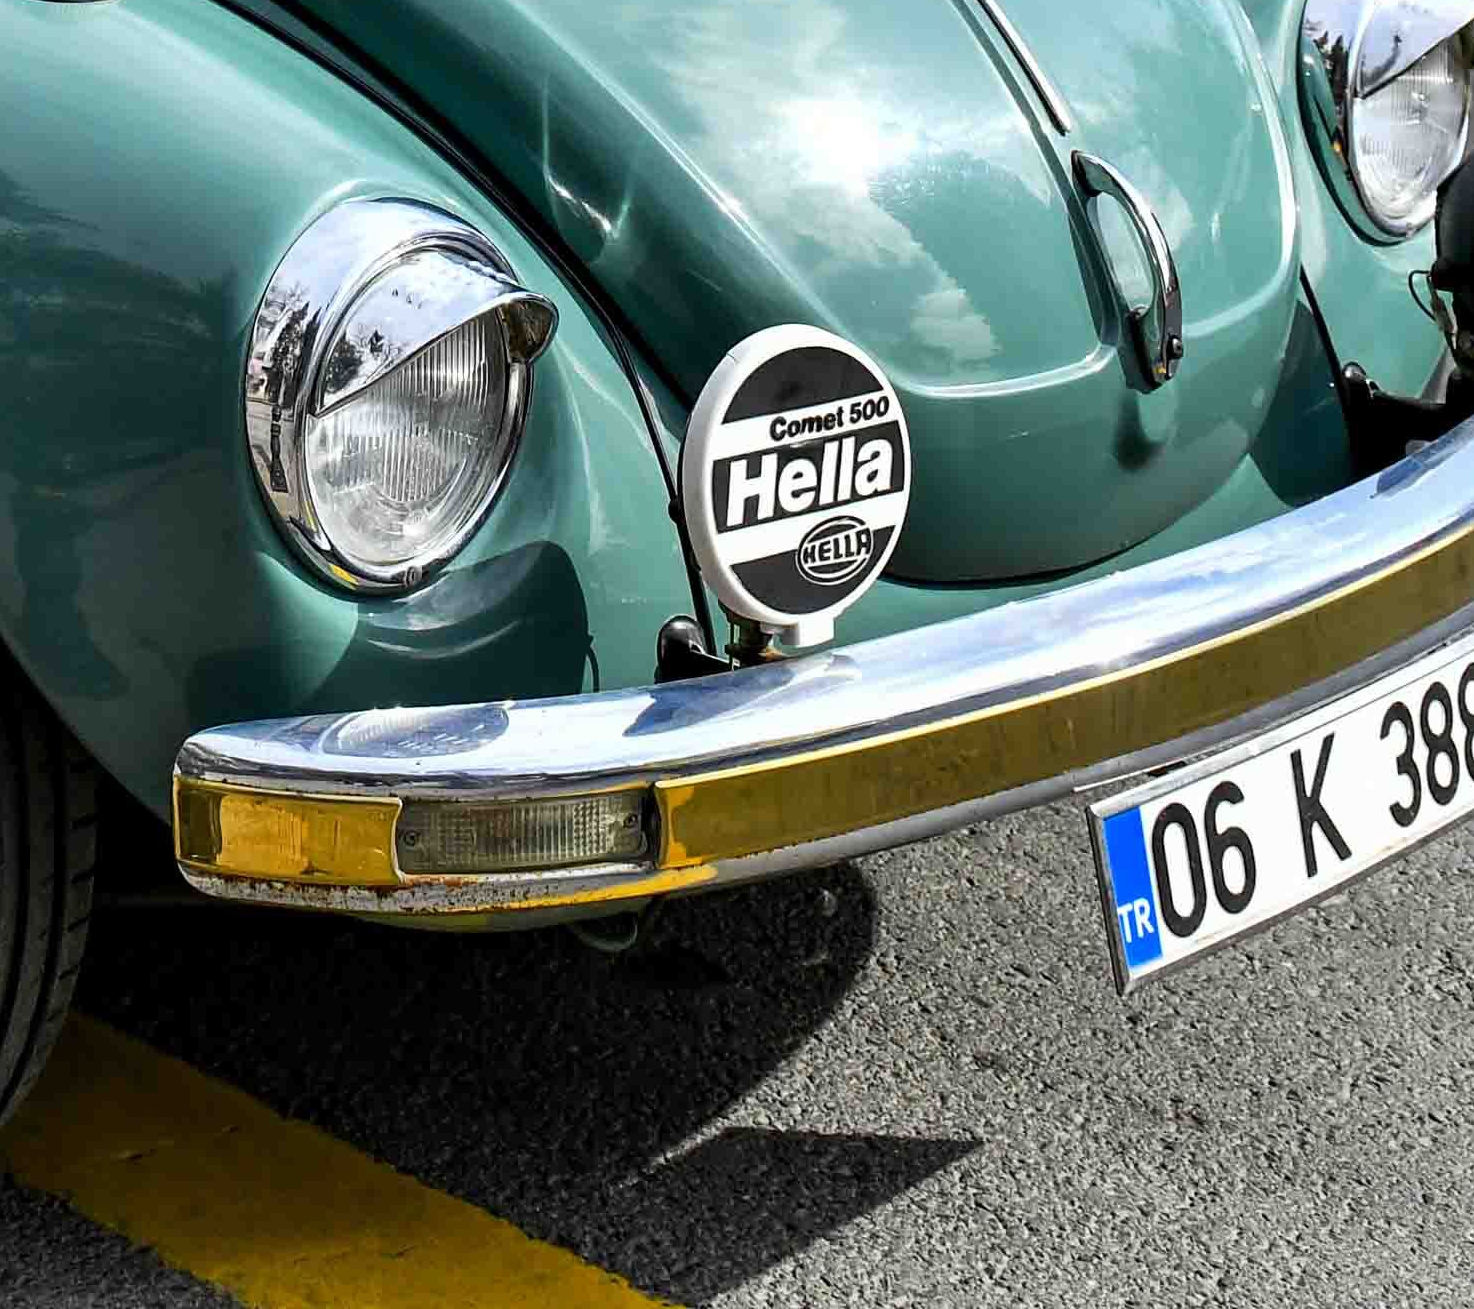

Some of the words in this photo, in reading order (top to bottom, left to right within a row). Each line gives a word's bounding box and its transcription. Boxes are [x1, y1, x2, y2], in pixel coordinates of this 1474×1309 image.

[769, 406, 844, 441] Comet
[849, 396, 890, 426] 500
[726, 437, 894, 528] Hella
[802, 527, 871, 566] HELLA
[1118, 899, 1154, 945] TR
[1151, 780, 1256, 938] 06
[1290, 732, 1353, 878] K
